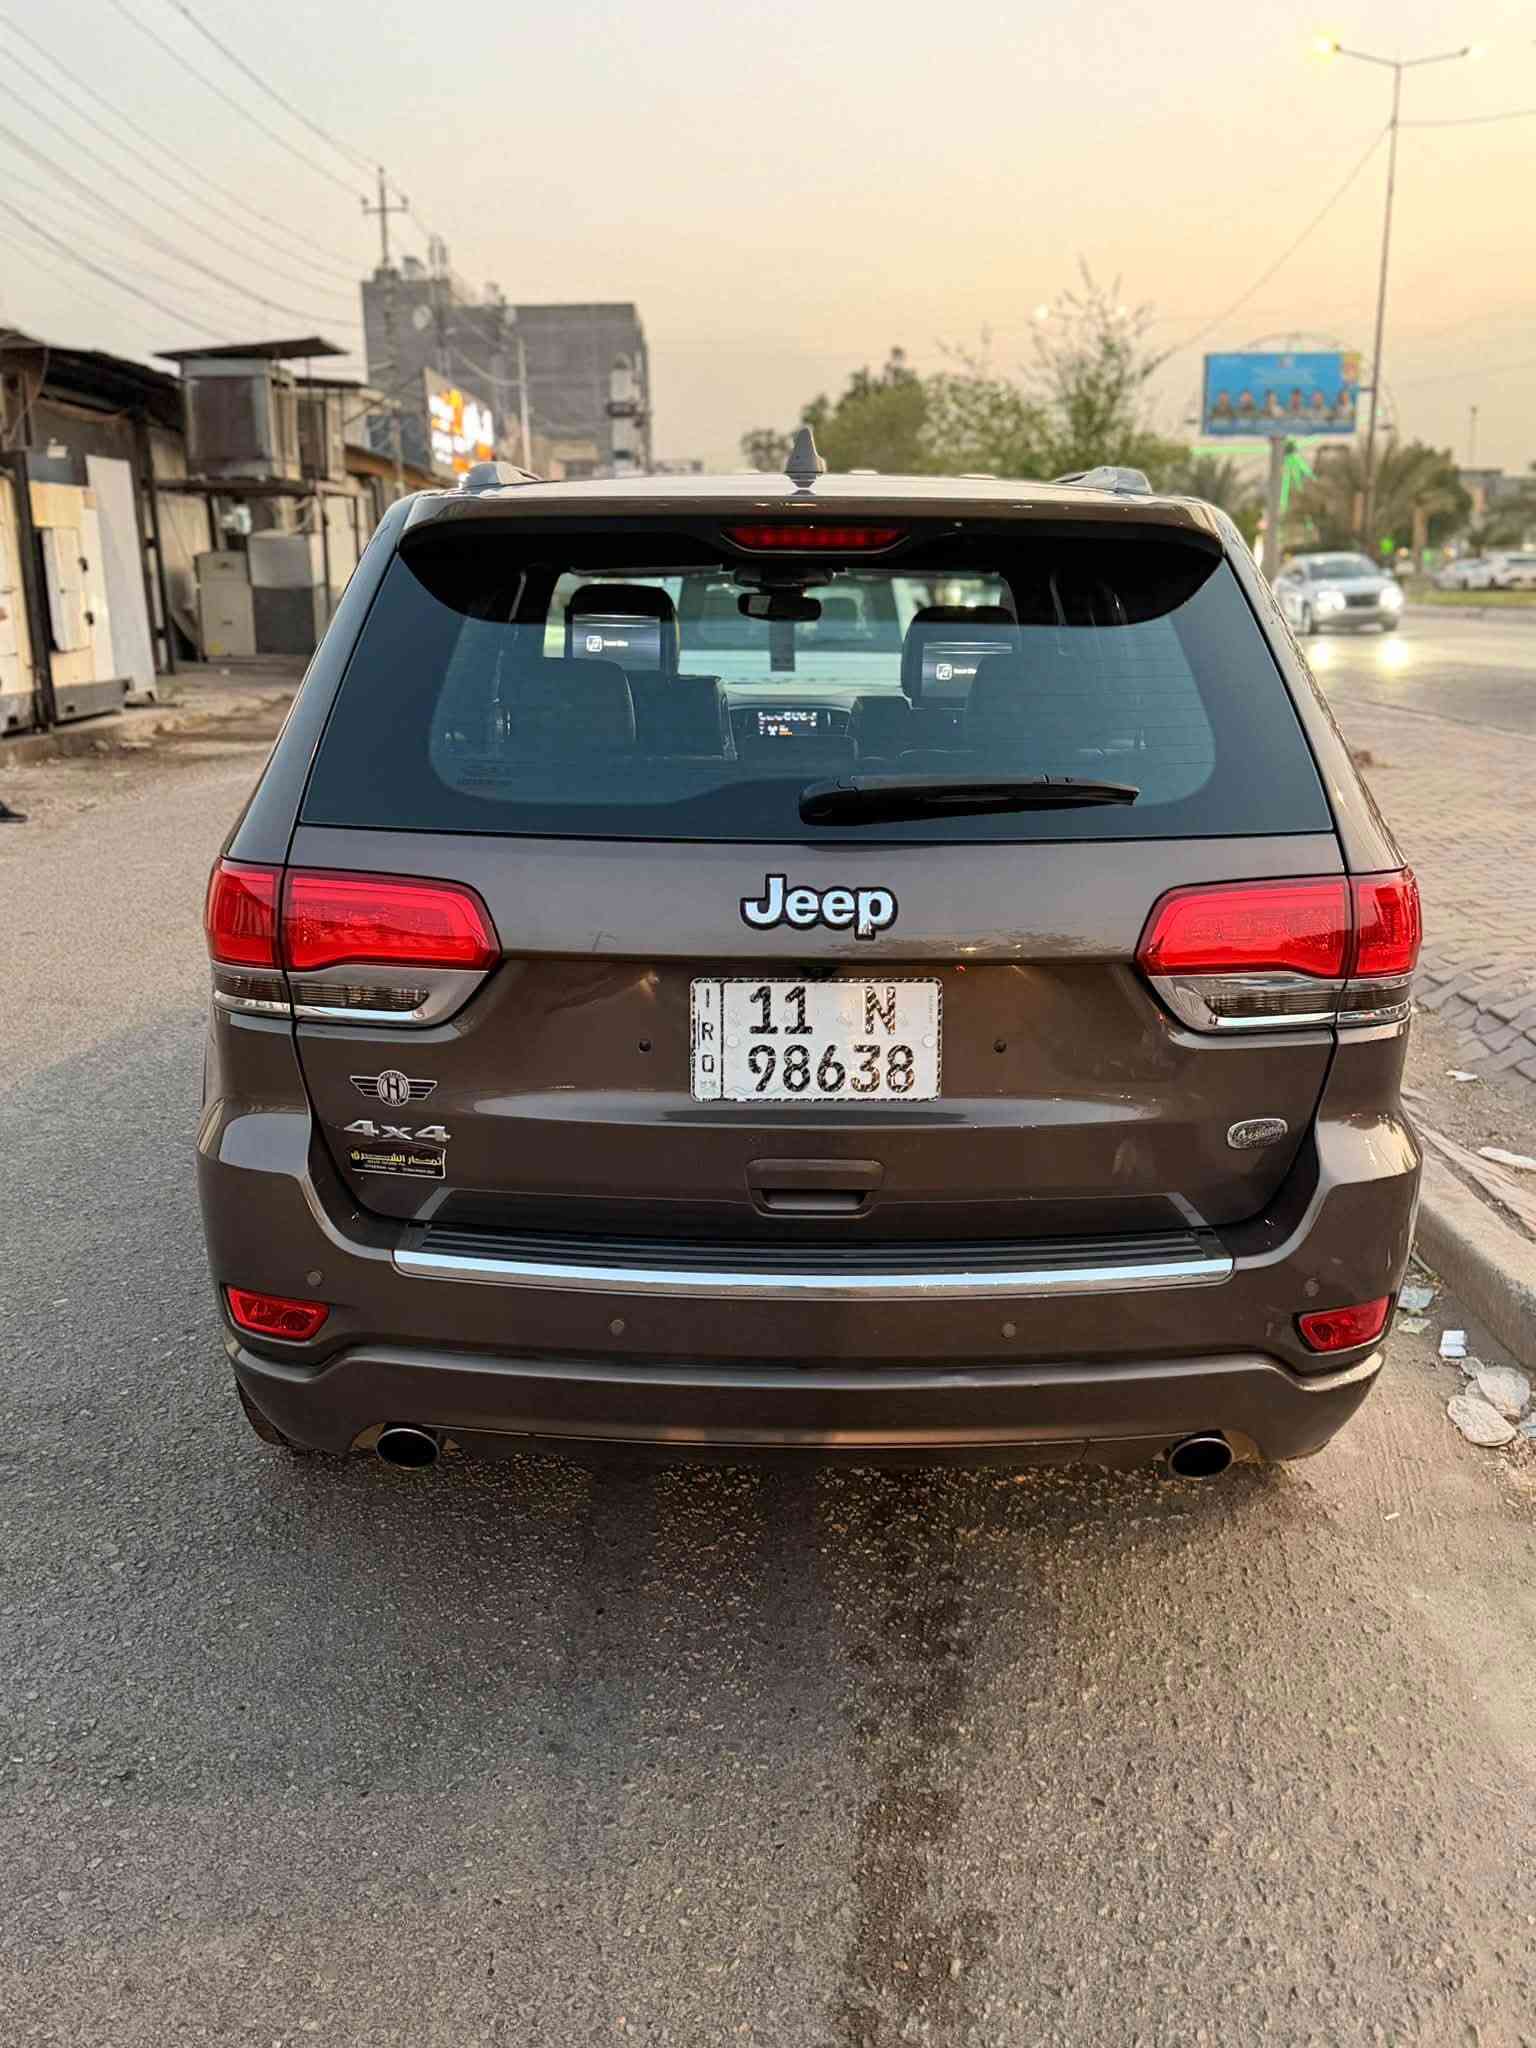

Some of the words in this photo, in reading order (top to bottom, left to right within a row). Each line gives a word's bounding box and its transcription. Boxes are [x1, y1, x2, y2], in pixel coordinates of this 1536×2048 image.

[740, 874, 898, 941] Jeep
[749, 986, 814, 1035] 11
[864, 986, 897, 1036] N
[747, 1044, 916, 1094] 98638
